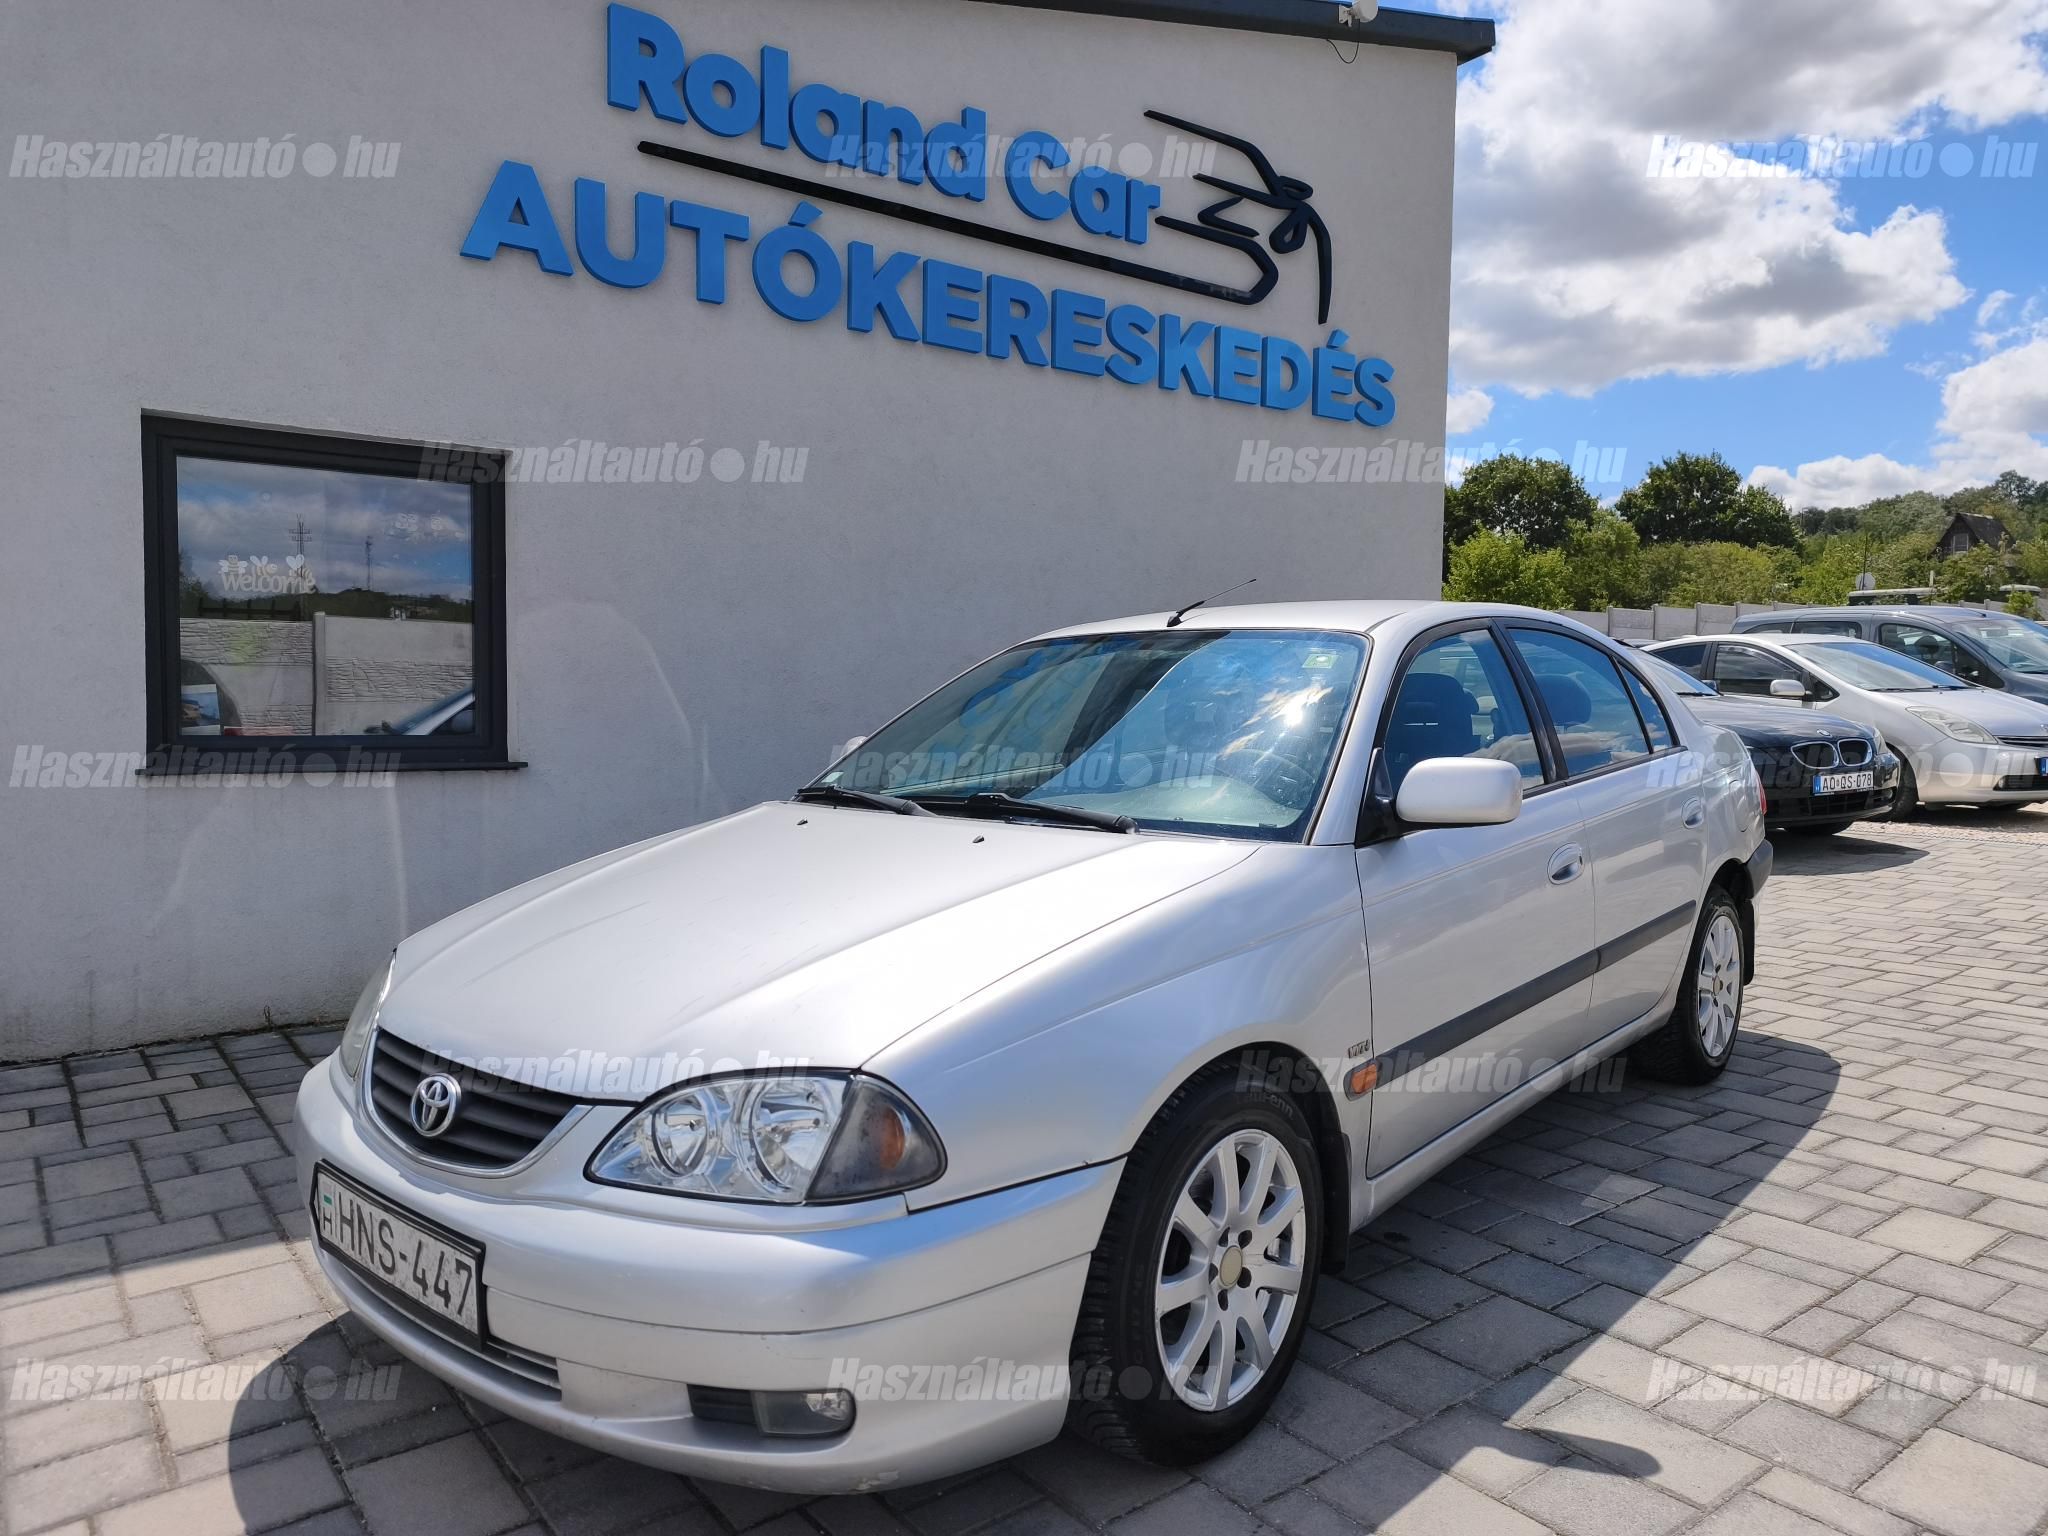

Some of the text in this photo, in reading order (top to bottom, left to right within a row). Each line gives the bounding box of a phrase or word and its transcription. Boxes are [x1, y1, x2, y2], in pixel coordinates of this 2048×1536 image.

[607, 3, 1160, 246] Roland Car
[460, 160, 1395, 428] AUTÓKERESKEDÉS
[338, 1192, 473, 1316] HNS-447
